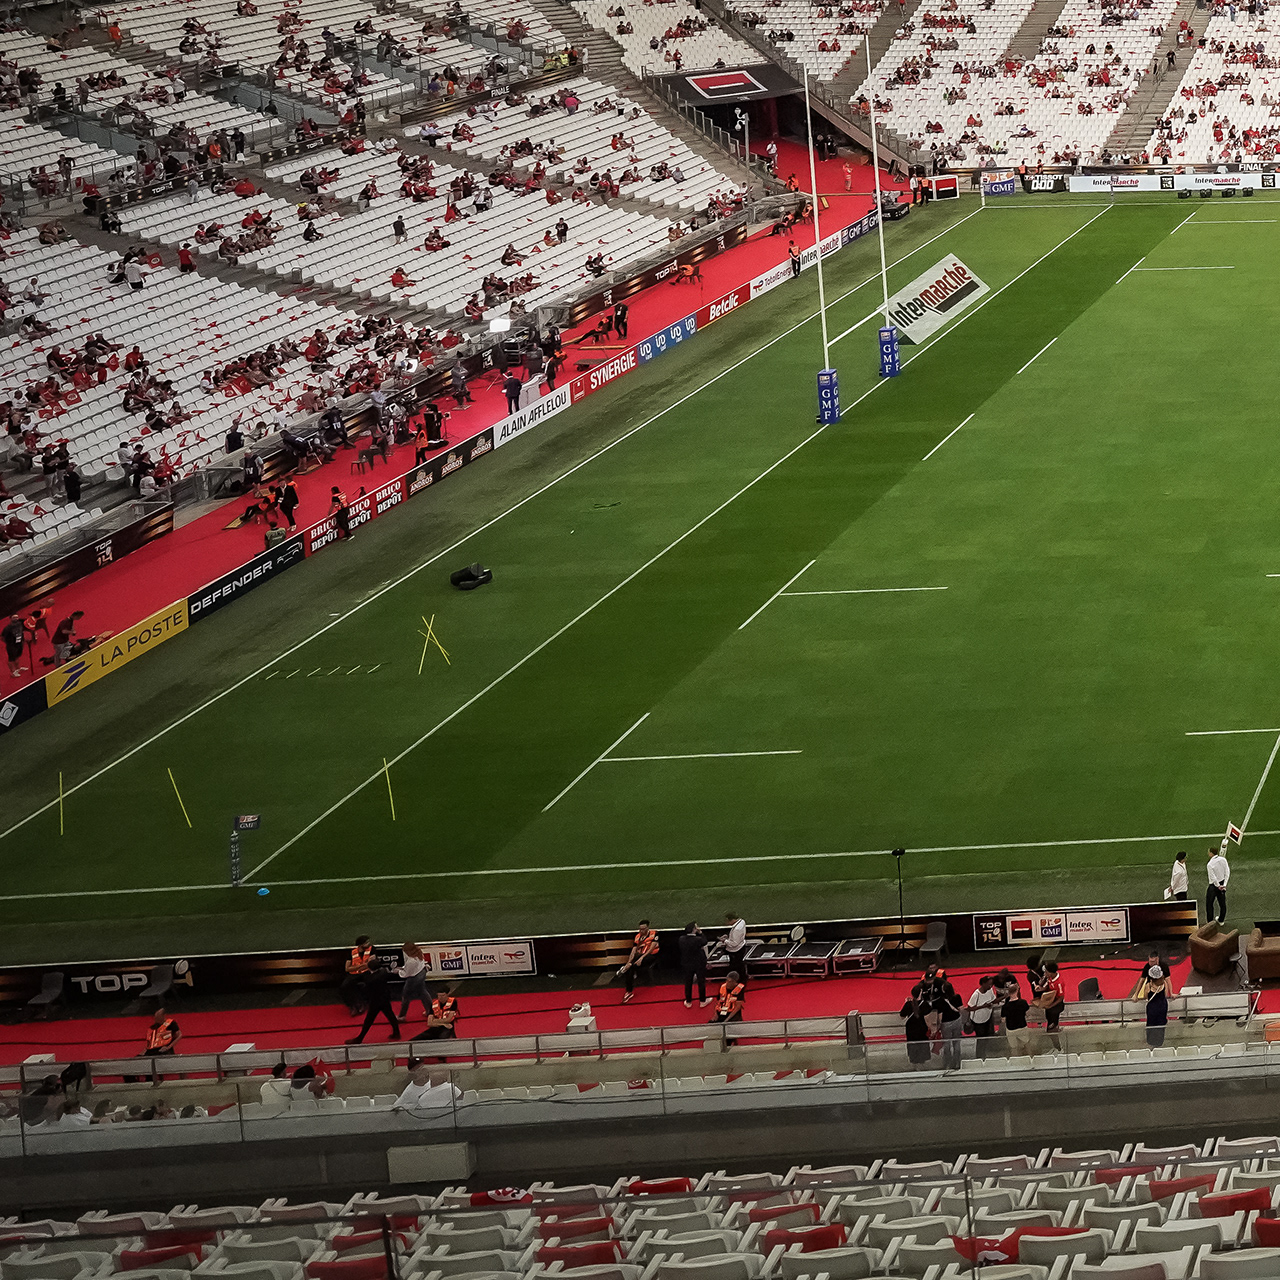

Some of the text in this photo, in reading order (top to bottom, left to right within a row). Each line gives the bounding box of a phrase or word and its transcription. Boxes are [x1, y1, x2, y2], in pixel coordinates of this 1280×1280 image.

[991, 183, 1014, 193] GMF
[888, 262, 972, 329] Intermarché
[709, 294, 739, 321] Betclic
[590, 348, 636, 390] SYNERGIE
[883, 345, 893, 374] GMF
[822, 388, 832, 420] GMF
[500, 391, 568, 440] ALAIN AFFLELOU
[470, 442, 491, 457] ANDROS
[441, 459, 463, 475] ANDROS
[376, 481, 402, 501] BRICO
[410, 475, 433, 492] ANDROS
[377, 492, 403, 514] DEPÔT
[310, 517, 337, 539] BRICO
[190, 560, 273, 615] DEFENDER
[101, 610, 183, 668] LA POSTE
[1042, 927, 1061, 936] GMF
[1069, 921, 1093, 931] Inter
[442, 960, 462, 969] GMF
[471, 953, 496, 963] Inter
